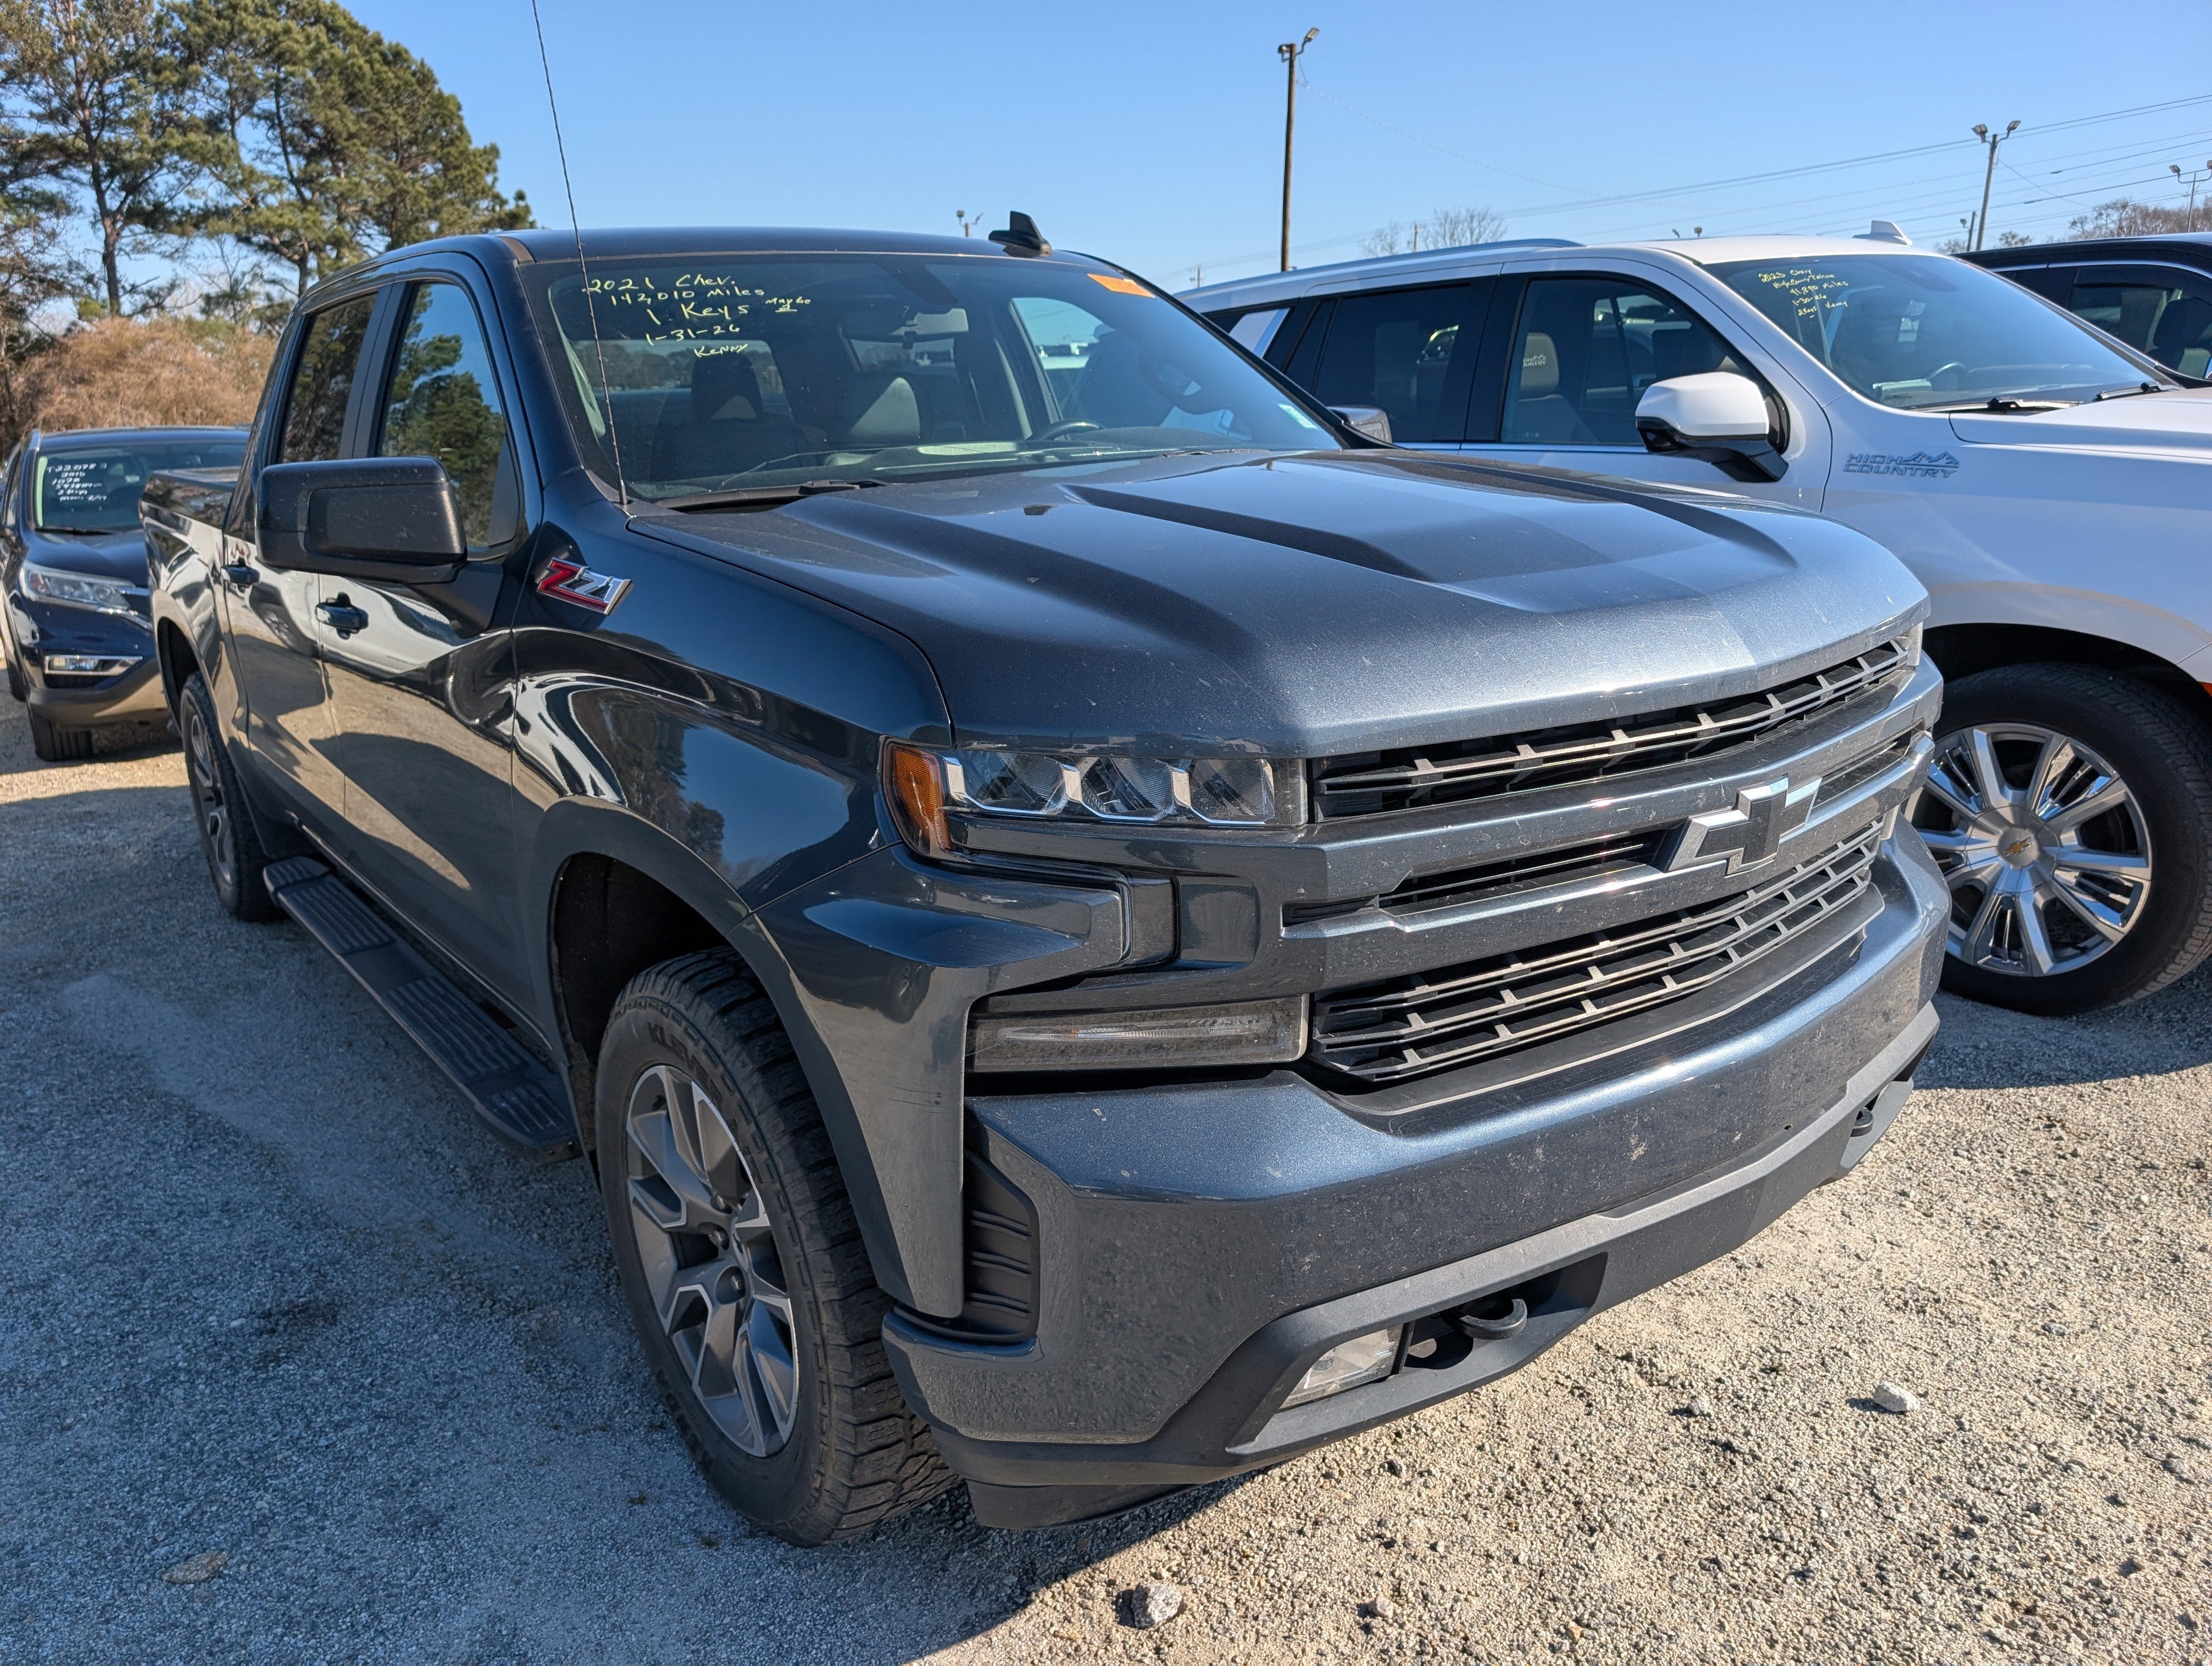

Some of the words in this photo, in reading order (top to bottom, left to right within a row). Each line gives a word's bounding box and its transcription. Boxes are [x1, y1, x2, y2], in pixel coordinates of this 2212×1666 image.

[582, 277, 655, 293] 2021
[611, 289, 695, 306] 142,010
[707, 286, 764, 297] Miles
[680, 302, 750, 320] Keys
[1846, 453, 1904, 465] HIGH
[1843, 463, 1957, 478] COUNTRY
[536, 556, 634, 616] Z71
[647, 1022, 724, 1104] KLEVER
